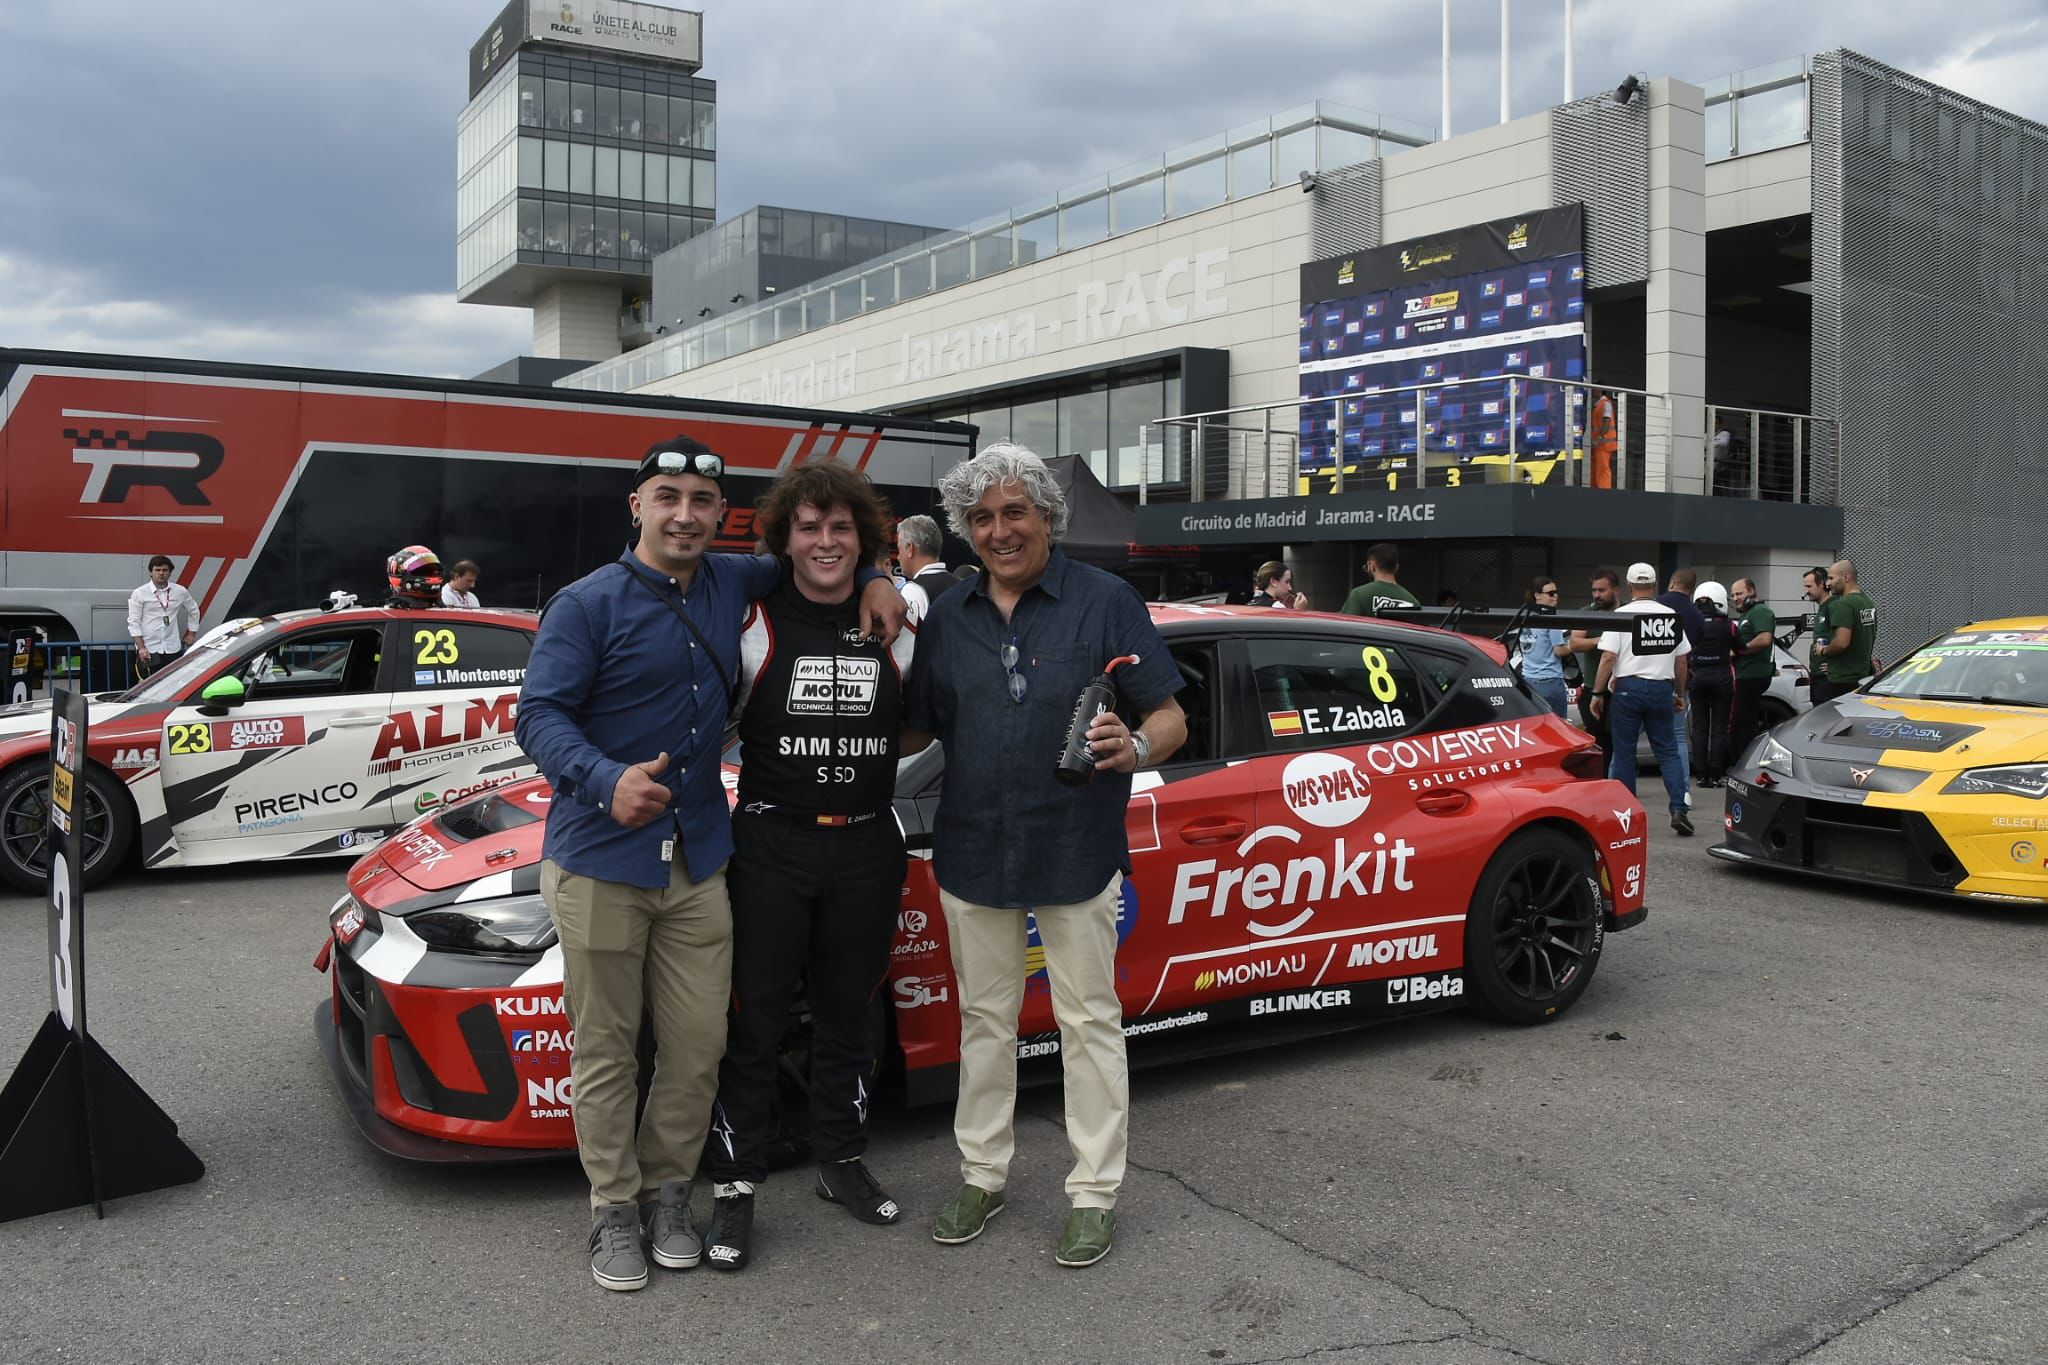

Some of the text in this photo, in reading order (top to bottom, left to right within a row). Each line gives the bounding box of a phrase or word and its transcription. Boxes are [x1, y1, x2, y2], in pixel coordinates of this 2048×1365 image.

[551, 23, 582, 35] RACE
[593, 11, 677, 37] ÚNETE AL CLUB
[760, 348, 857, 408] Madrid
[895, 312, 1037, 385] Jarama
[1075, 245, 1230, 344] RACE
[1386, 472, 1397, 491] 1
[1446, 467, 1461, 488] 3
[1181, 513, 1232, 532] Circuito
[1234, 513, 1252, 528] de
[1255, 510, 1306, 529] Madrid
[1316, 508, 1375, 526] Jarama
[1387, 503, 1436, 522] RACE
[1640, 617, 1676, 639] NGK
[414, 629, 459, 665] 23
[1641, 639, 1658, 647] SPARK
[814, 664, 872, 676] MONLAU
[1362, 646, 1398, 703] 8
[1897, 656, 1943, 675] 70
[802, 683, 863, 698] MOTUL
[1471, 677, 1513, 689] SAMSUNG
[792, 703, 867, 712] TECHNICAL SCHOOL
[1490, 696, 1505, 706] SSD
[231, 719, 284, 736] AUTO
[169, 722, 211, 755] 23
[231, 733, 284, 749] SPORT
[1367, 723, 1536, 775] COVERFIX
[404, 752, 465, 769] Honda
[1409, 758, 1523, 791] Soluciones
[54, 774, 70, 803] Spain
[235, 782, 358, 824] PIRENCO
[238, 813, 304, 833] PATAGONIA
[1992, 817, 2035, 828] SELECT
[1610, 837, 1641, 850] CUPRA
[1167, 832, 1416, 925] Frenkit
[1625, 863, 1641, 882] GLS
[53, 851, 74, 1032] 3
[896, 940, 940, 956] odosa
[1346, 934, 1439, 968] MOTUL
[1216, 953, 1306, 988] MONLAU
[1409, 974, 1464, 1002] Beta
[1250, 989, 1351, 1016] BLINKER
[530, 1108, 570, 1119] SPARK
[709, 1246, 741, 1261] OMP
